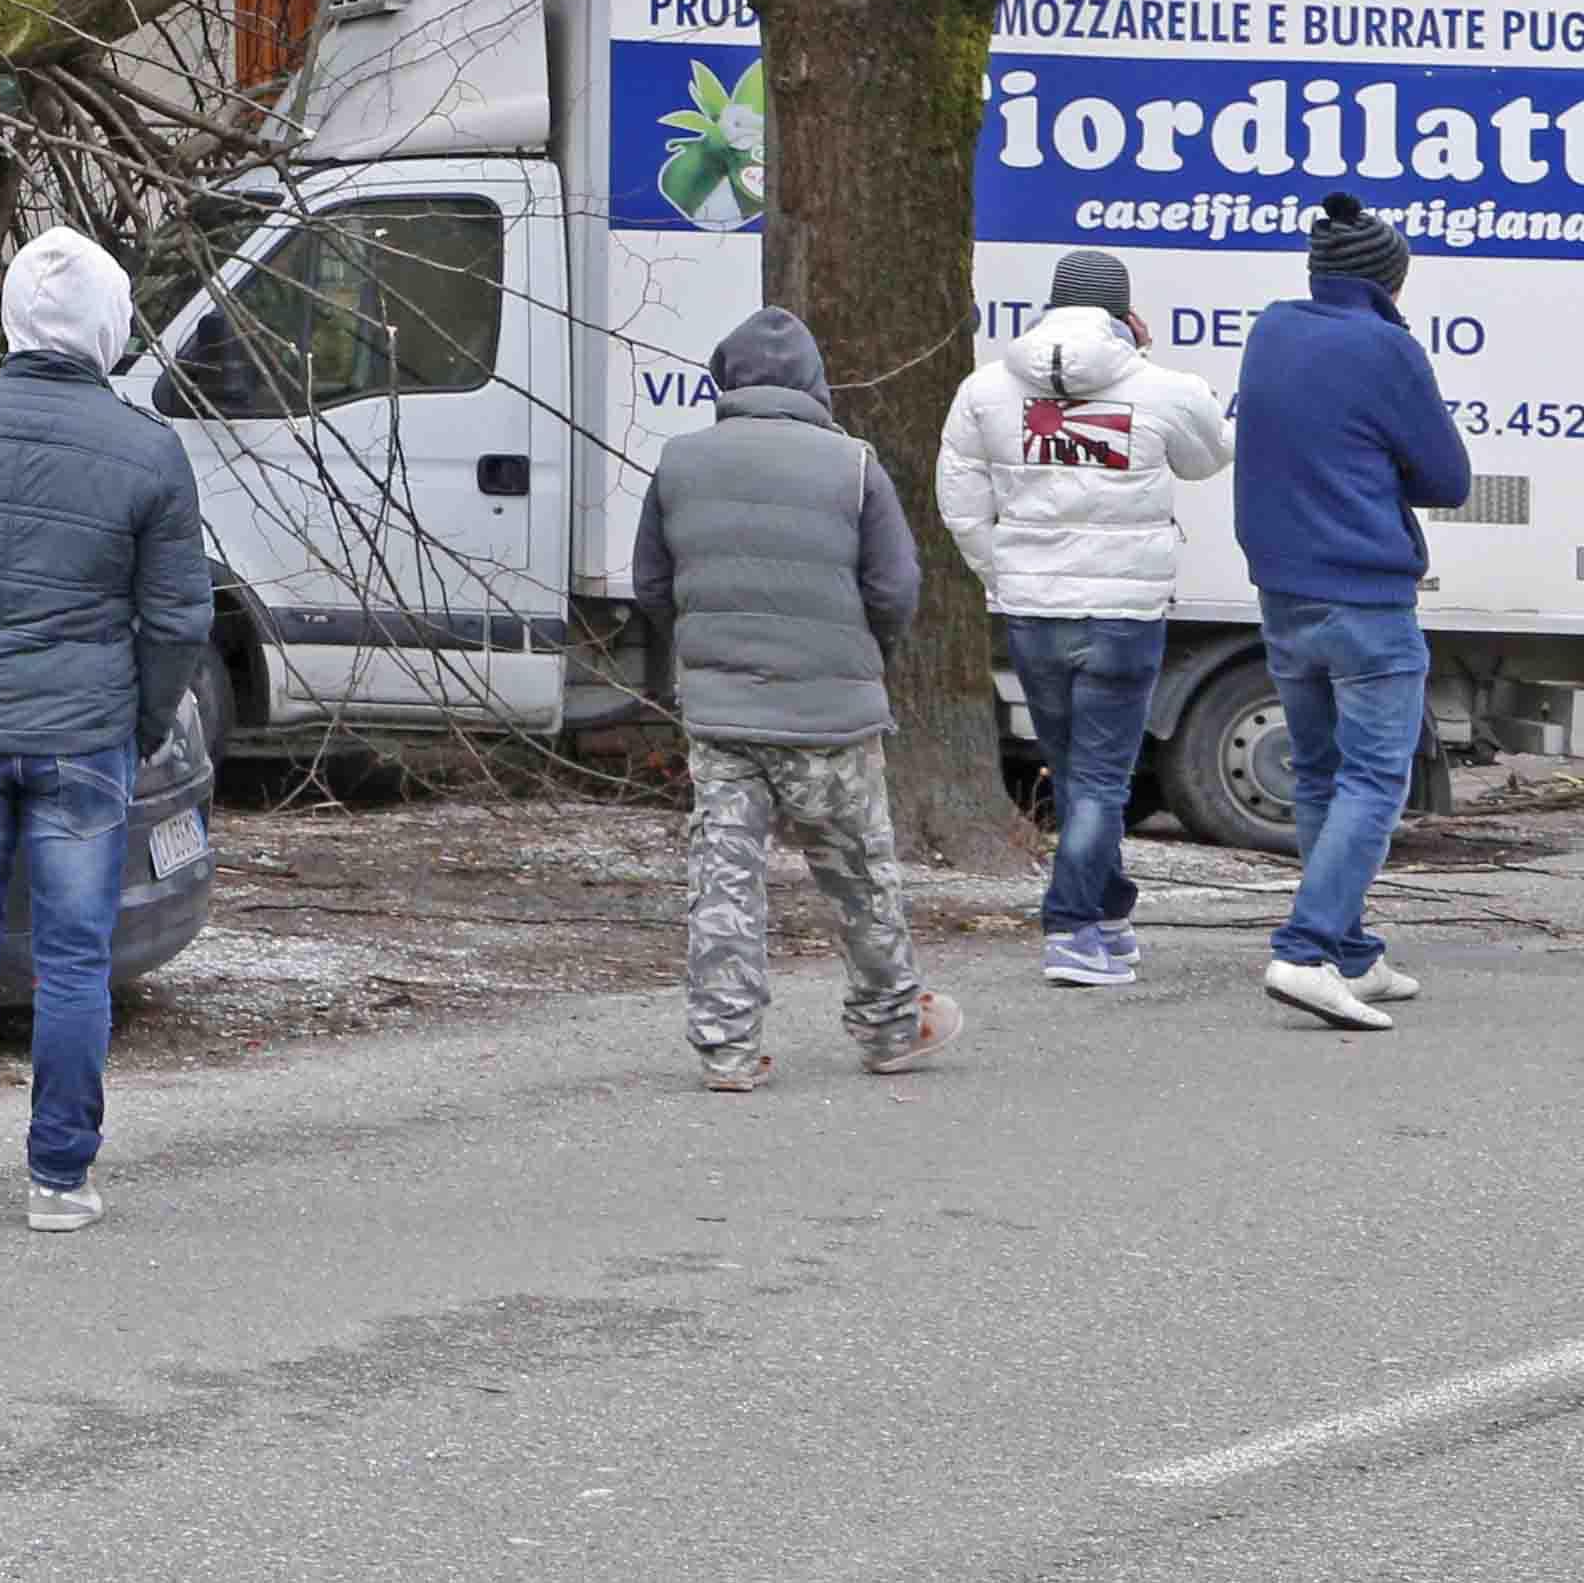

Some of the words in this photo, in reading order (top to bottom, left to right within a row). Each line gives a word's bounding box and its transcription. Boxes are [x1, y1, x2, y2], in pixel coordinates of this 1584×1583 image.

[1268, 3, 1287, 45] E
[1304, 5, 1486, 50] BURRATE
[982, 70, 1584, 185] iordilatt
[643, 372, 718, 407] VIA
